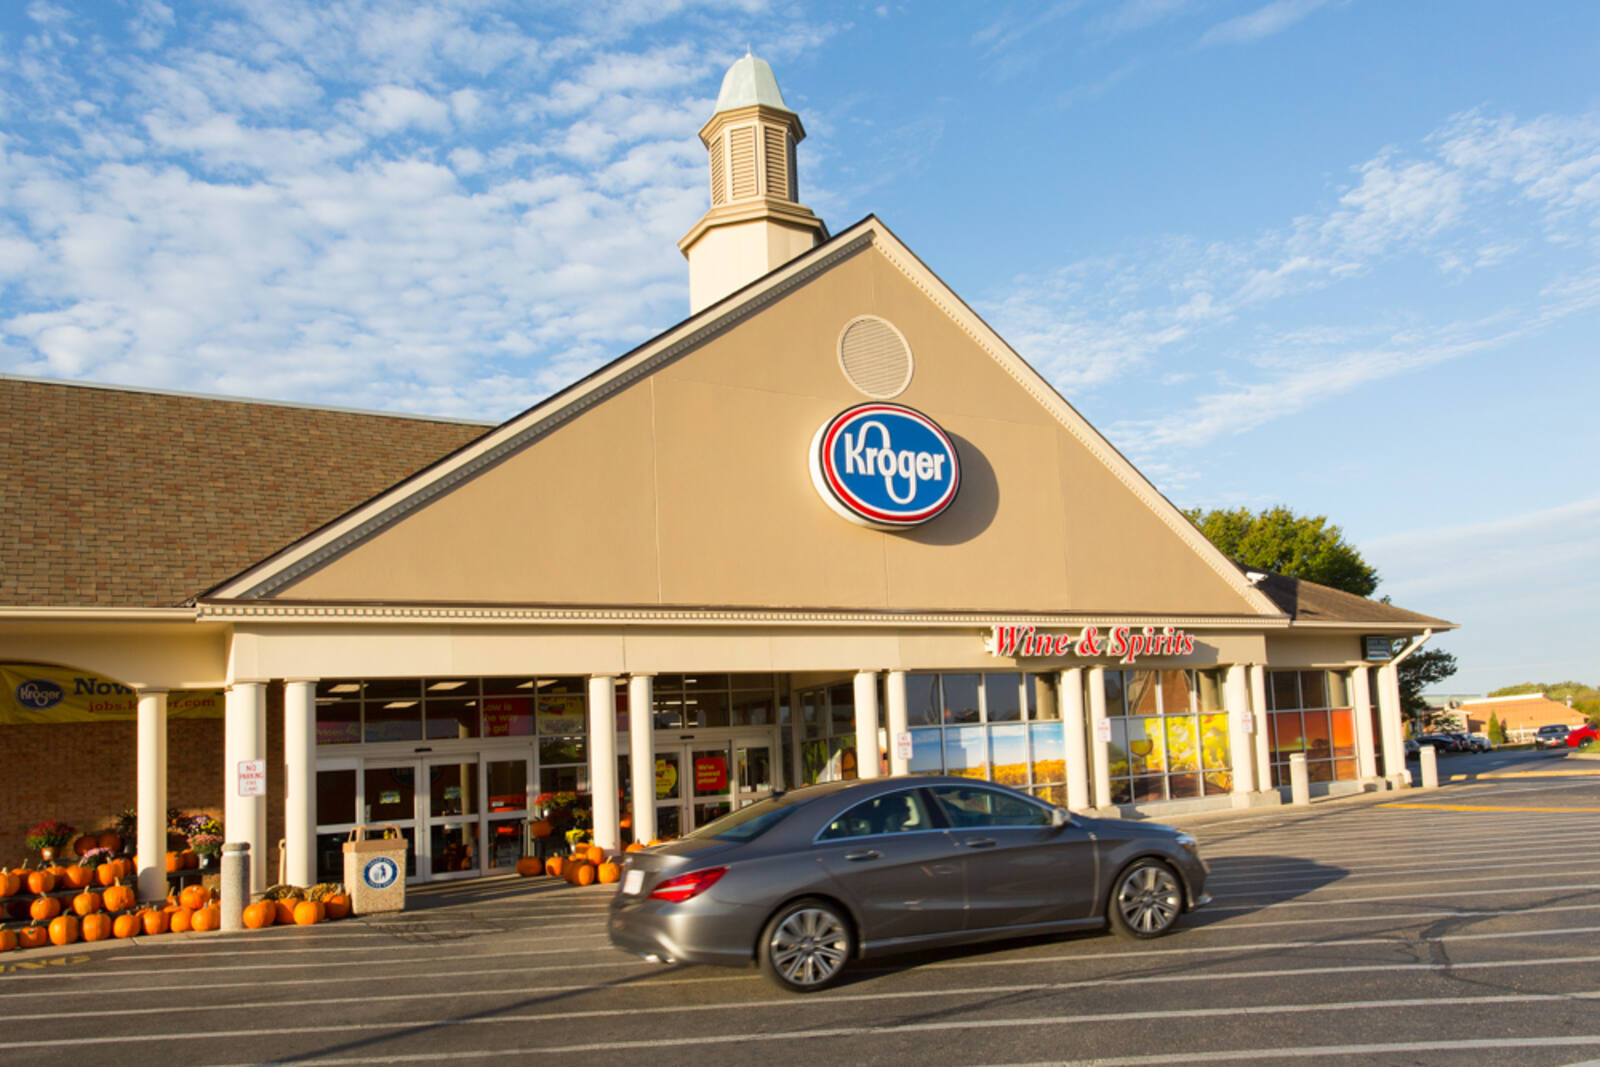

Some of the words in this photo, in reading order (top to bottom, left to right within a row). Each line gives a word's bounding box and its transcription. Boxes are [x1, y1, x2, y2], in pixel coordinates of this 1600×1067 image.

[844, 421, 945, 505] Kroger
[995, 625, 1069, 656] Wine
[1077, 625, 1101, 656] &
[1110, 626, 1194, 663] Spirits
[20, 683, 60, 706] Kroger
